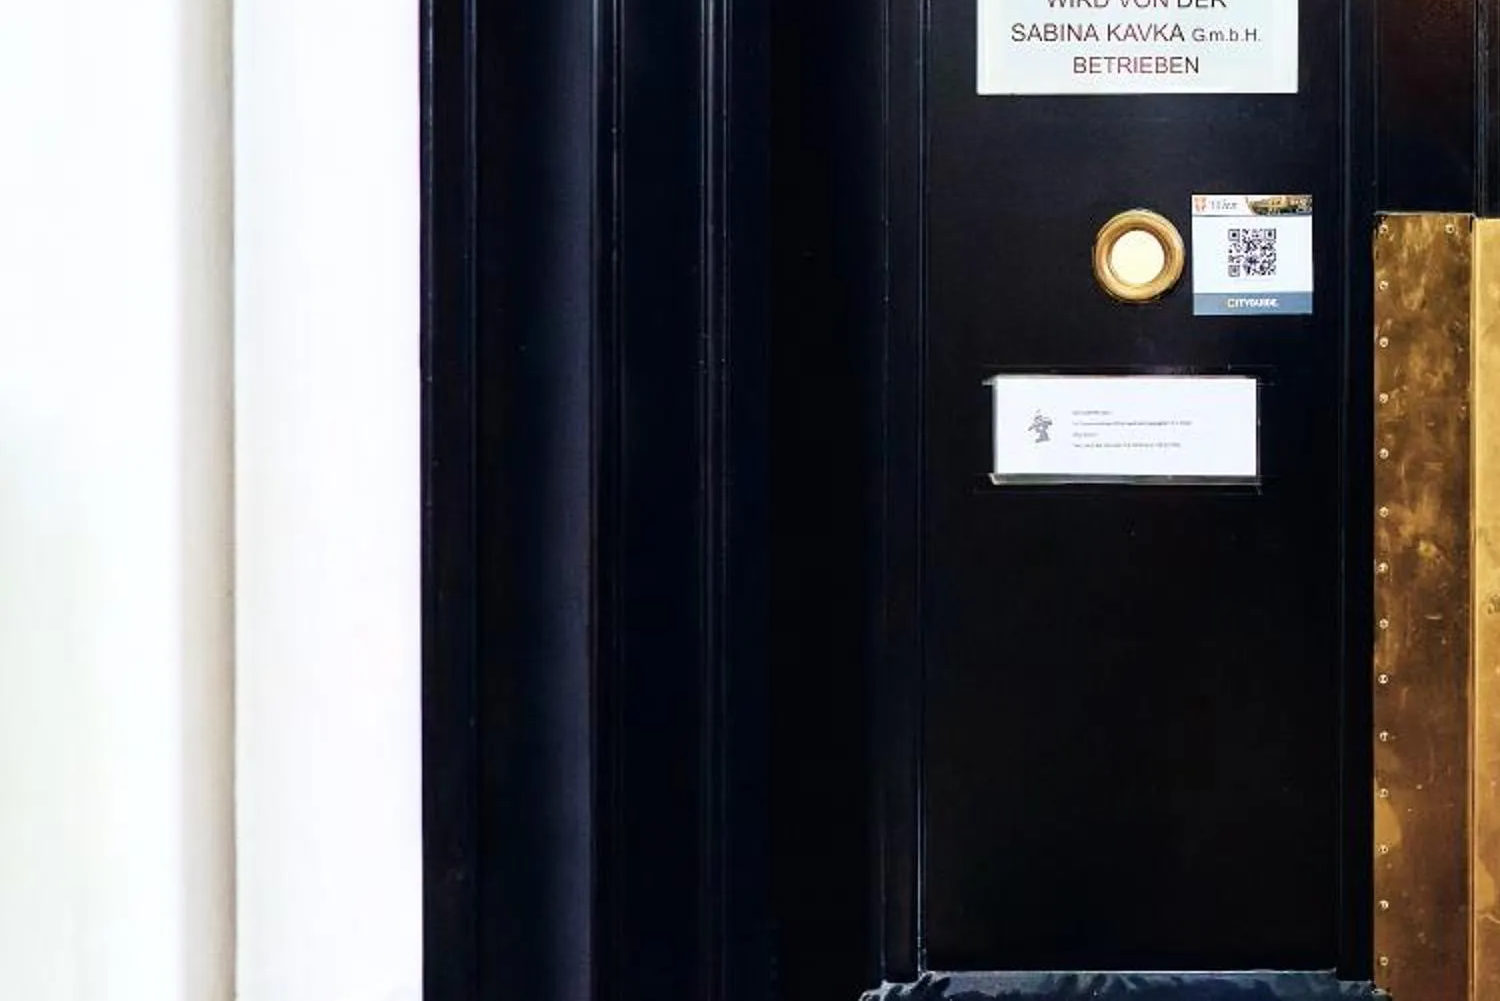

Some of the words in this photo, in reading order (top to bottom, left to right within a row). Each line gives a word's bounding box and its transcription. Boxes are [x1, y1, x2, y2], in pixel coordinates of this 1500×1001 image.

[1011, 22, 1100, 42] SABINA
[1107, 22, 1185, 42] KAVKA
[1192, 27, 1261, 42] G.m.b.H.
[1073, 56, 1200, 74] BETRIEBEN
